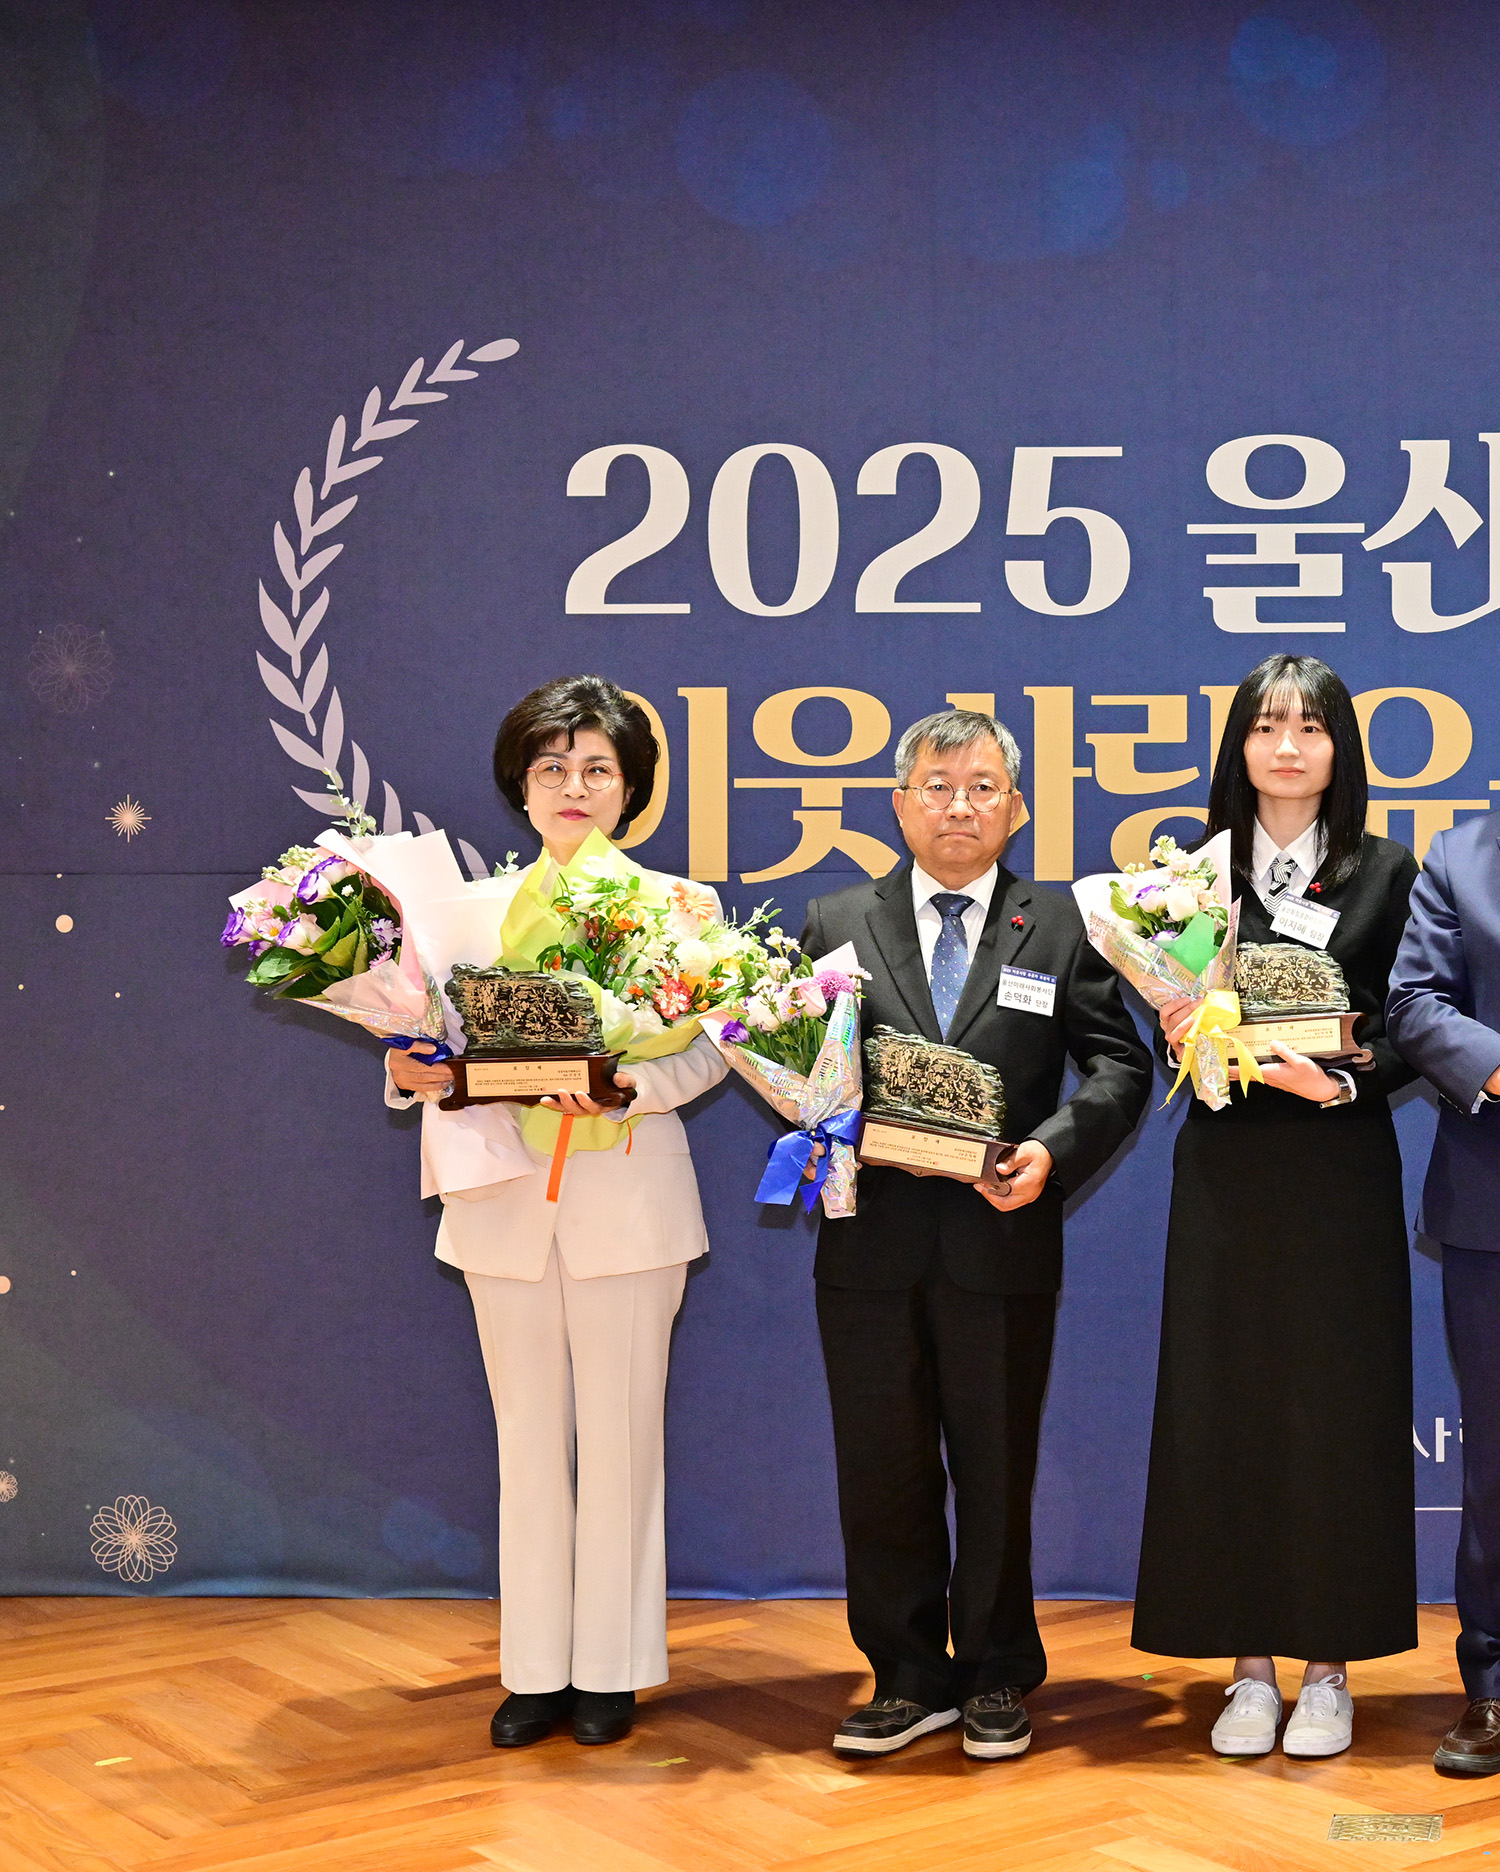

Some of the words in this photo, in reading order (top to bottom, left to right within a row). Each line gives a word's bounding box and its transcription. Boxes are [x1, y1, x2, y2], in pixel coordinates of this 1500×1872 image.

[565, 442, 1131, 617] 2025
[1278, 916, 1307, 934] 이지혜
[1309, 930, 1325, 942] 팀장
[1003, 990, 1032, 1006] 손덕화
[1035, 999, 1048, 1009] 단장
